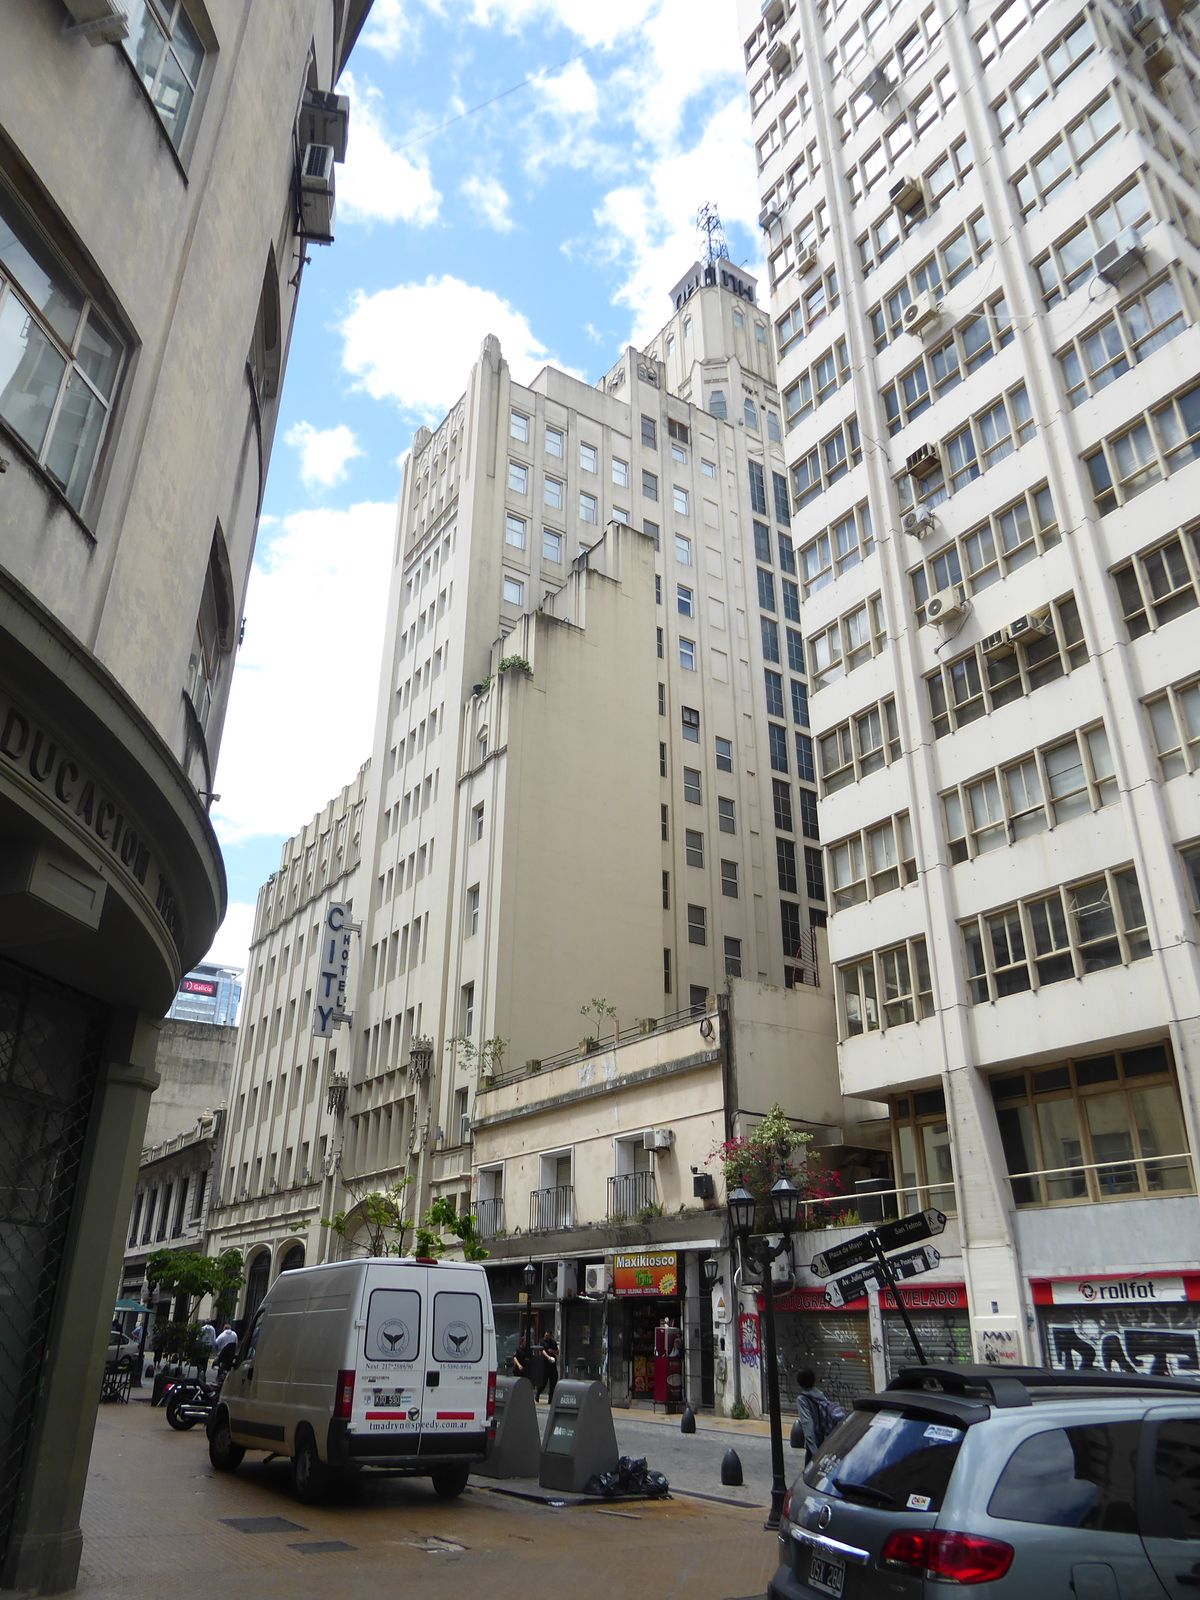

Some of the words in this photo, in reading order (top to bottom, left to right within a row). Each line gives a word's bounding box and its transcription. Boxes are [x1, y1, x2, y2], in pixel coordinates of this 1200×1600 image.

[318, 907, 344, 1032] CITY
[336, 934, 350, 1007] HOTEL
[193, 984, 212, 992] Galicia
[894, 1226, 905, 1235] San
[905, 1220, 922, 1231] Telmo
[828, 1250, 842, 1259] Plaza
[848, 1241, 863, 1250] Mayo
[616, 1255, 674, 1268] Maxikiosco
[841, 1278, 850, 1286] Av.
[850, 1273, 863, 1283] Julio
[862, 1268, 875, 1278] Roca
[1100, 1281, 1156, 1300] rollfot
[369, 1420, 468, 1431] tmadryn@speedy.com.ar
